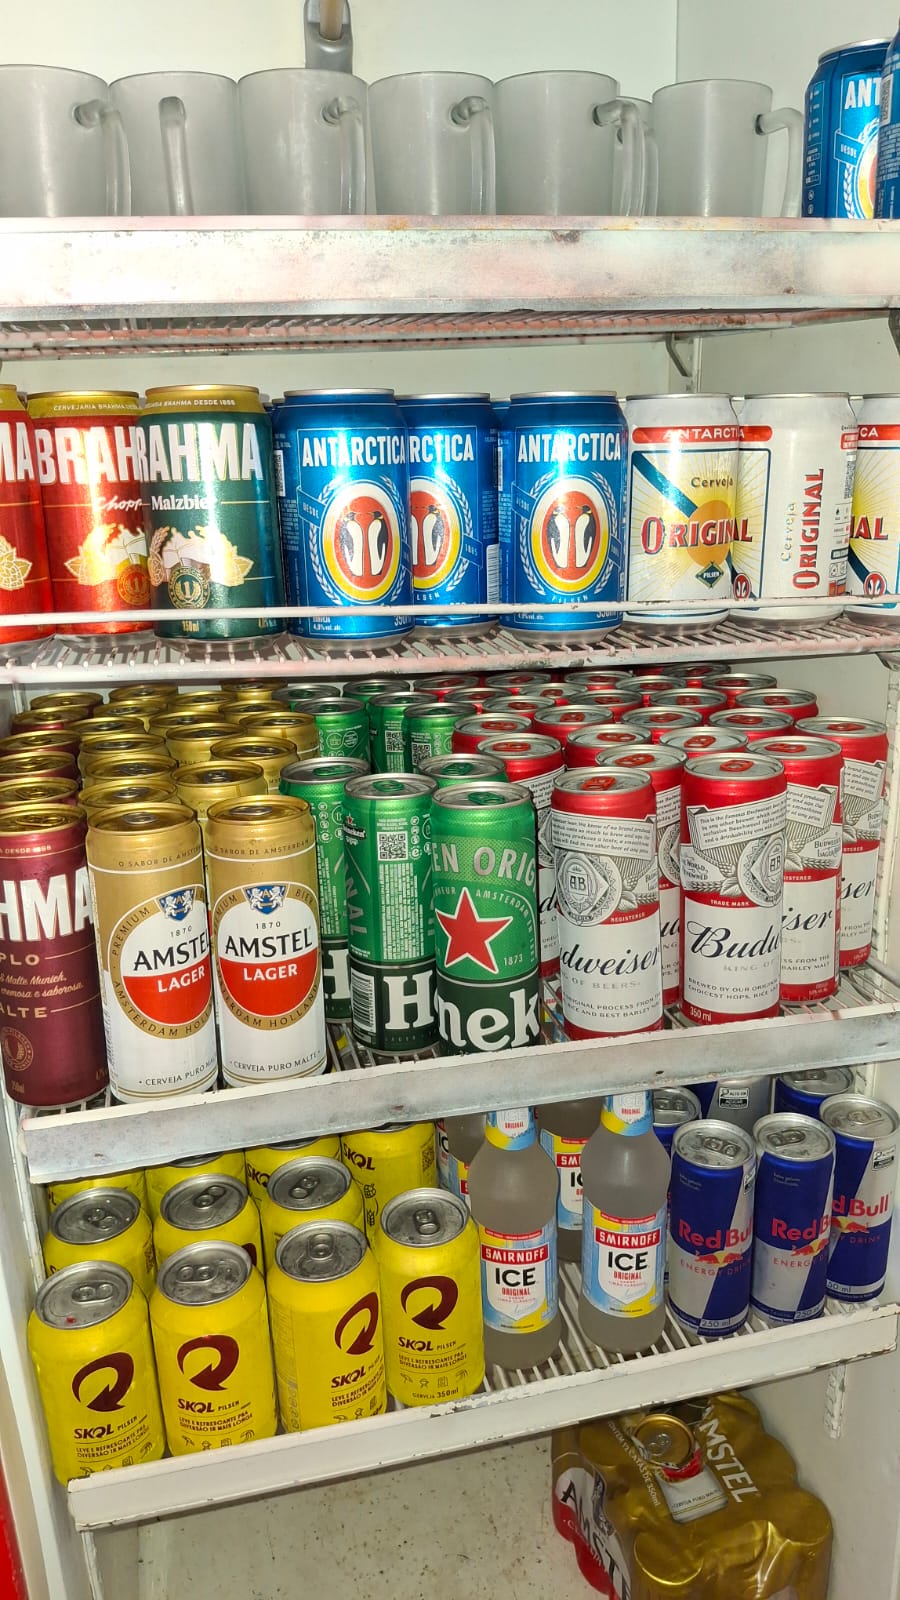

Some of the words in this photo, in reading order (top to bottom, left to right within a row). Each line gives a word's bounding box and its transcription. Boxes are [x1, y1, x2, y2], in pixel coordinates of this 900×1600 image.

[34, 425, 140, 485] BRAH
[302, 434, 407, 467] ANTARCTICA
[409, 433, 475, 463] RCTICA
[518, 432, 621, 463] ANTARCTICA
[690, 476, 734, 489] Cerveja
[151, 494, 214, 511] Malzbie
[780, 502, 796, 562] Cerveja
[792, 468, 824, 590] ORIGINAL
[128, 858, 159, 867] SABOR
[841, 877, 876, 900] ser
[255, 921, 281, 930] 1870
[225, 927, 313, 959] AMSTEL
[157, 965, 205, 993] LAGER
[243, 963, 298, 981] LAGER
[688, 977, 717, 991] BREWED
[688, 984, 723, 999] CHOICEST
[114, 981, 178, 1037] AMSTERDAM
[269, 984, 318, 1028] HOLLAND
[690, 1006, 702, 1018] 350
[702, 1012, 712, 1022] ml
[233, 1061, 265, 1072] CERVEJA
[268, 1062, 292, 1072] PURO
[294, 1051, 317, 1067] MALTE
[145, 1075, 182, 1086] CERVEJA
[184, 1064, 205, 1079] PURO
[343, 1142, 376, 1171] SKOL
[850, 1194, 889, 1217] Bull
[599, 1231, 658, 1247] SMIRNOFF
[678, 1218, 722, 1249] Red
[771, 1217, 817, 1241] Red
[485, 1246, 545, 1263] SMIRNOFF
[607, 1251, 649, 1271] ICE
[613, 1271, 642, 1280] ORIGINAL
[680, 1258, 723, 1276] ENERGY
[495, 1267, 536, 1288] ICE
[841, 1282, 851, 1293] ml
[501, 1287, 531, 1297] ORIGINAL
[701, 1319, 720, 1327] 250
[721, 1318, 731, 1327] ml
[398, 1336, 434, 1352] SKOL
[330, 1365, 366, 1389] SKOL
[436, 1387, 459, 1399] 350ml
[177, 1398, 215, 1414] SKOL
[218, 1400, 240, 1412] PILSEN
[74, 1423, 115, 1439] SKOL
